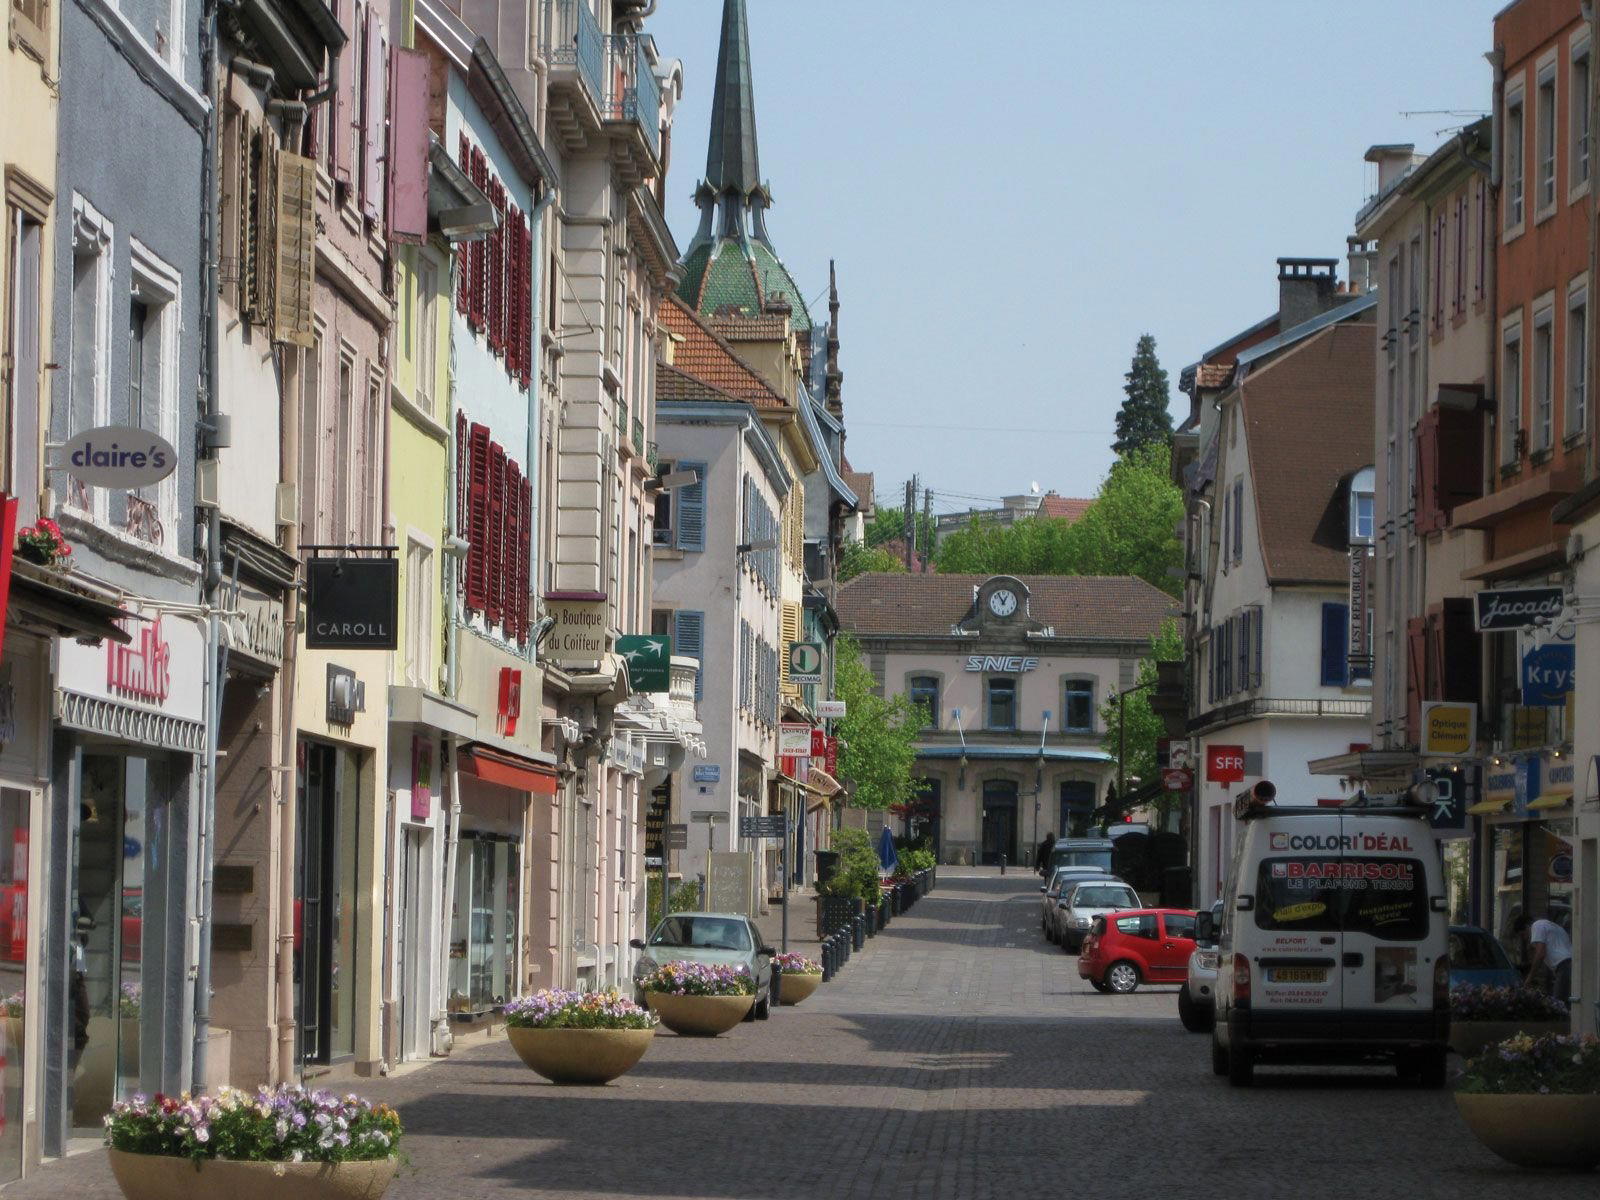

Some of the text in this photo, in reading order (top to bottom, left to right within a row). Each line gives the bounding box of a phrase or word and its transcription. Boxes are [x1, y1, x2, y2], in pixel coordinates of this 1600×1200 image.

[71, 442, 165, 468] claire's
[548, 608, 602, 629] La Boutique
[316, 622, 387, 636] CAROLL
[548, 633, 600, 651] du Coiffeur
[966, 655, 1039, 673] SNCF
[1432, 719, 1467, 730] Optique
[1216, 757, 1244, 770] SFR
[1287, 862, 1413, 880] BARRISOL
[1287, 879, 1415, 891] LE PLAFOND TENDU
